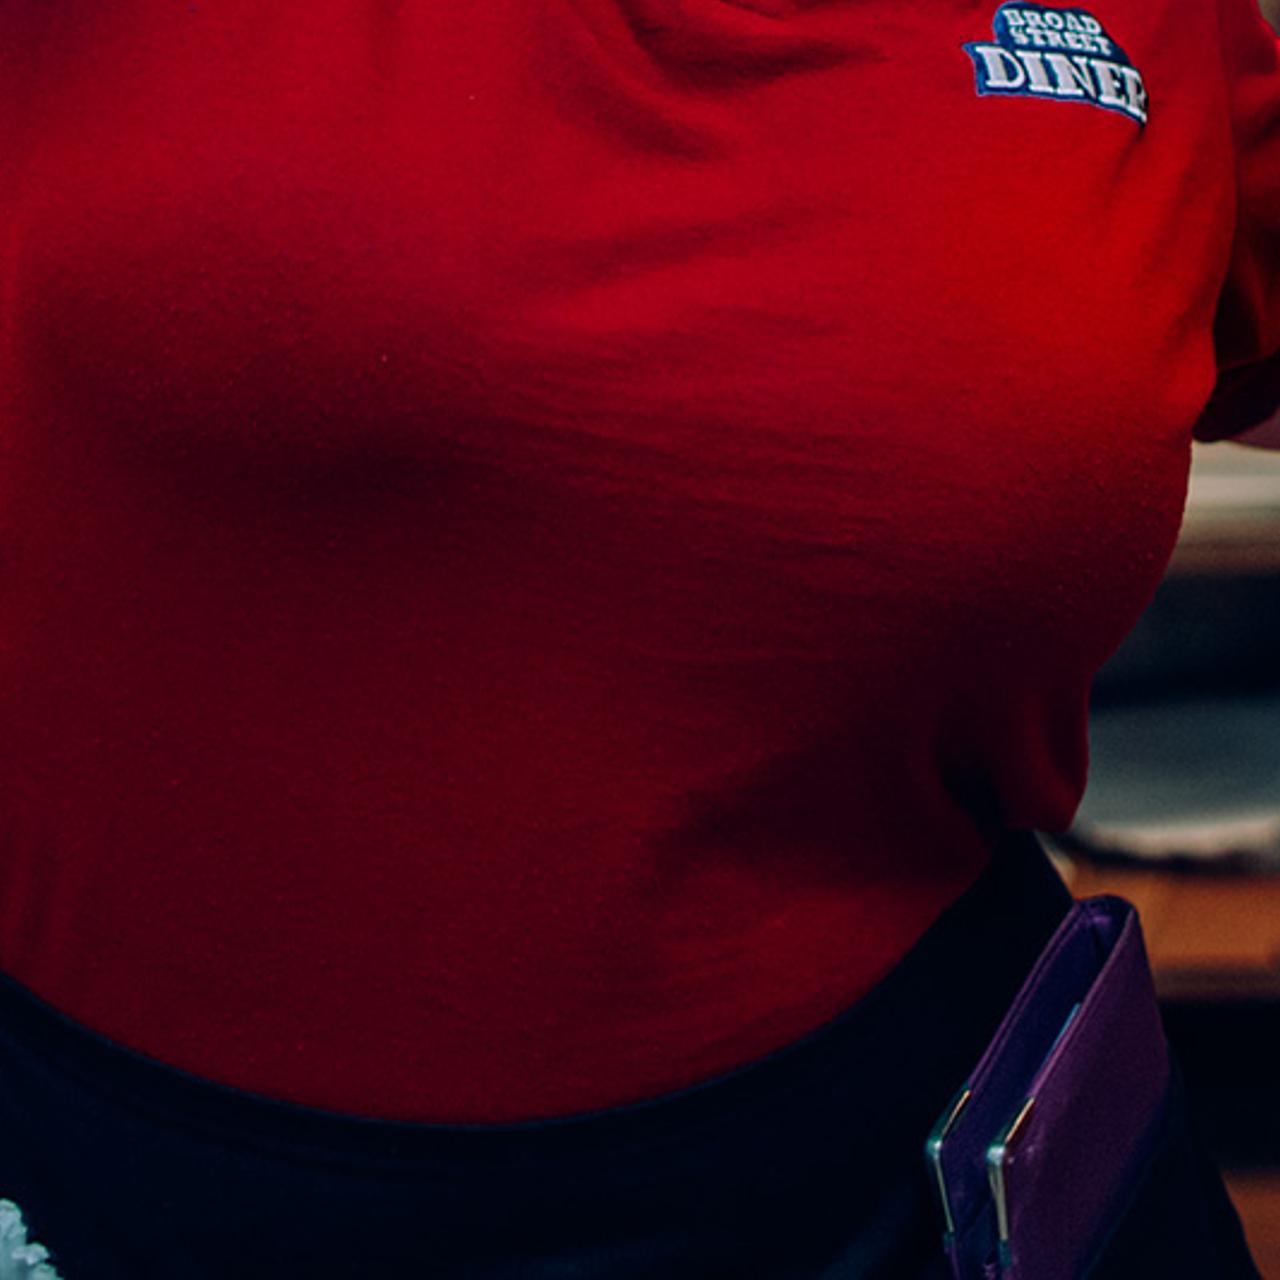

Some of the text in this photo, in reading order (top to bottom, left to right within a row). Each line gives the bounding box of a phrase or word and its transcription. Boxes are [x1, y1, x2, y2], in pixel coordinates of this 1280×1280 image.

[1002, 8, 1103, 34] BROAD
[1008, 26, 1113, 56] STREET
[975, 45, 1148, 123] DINER
